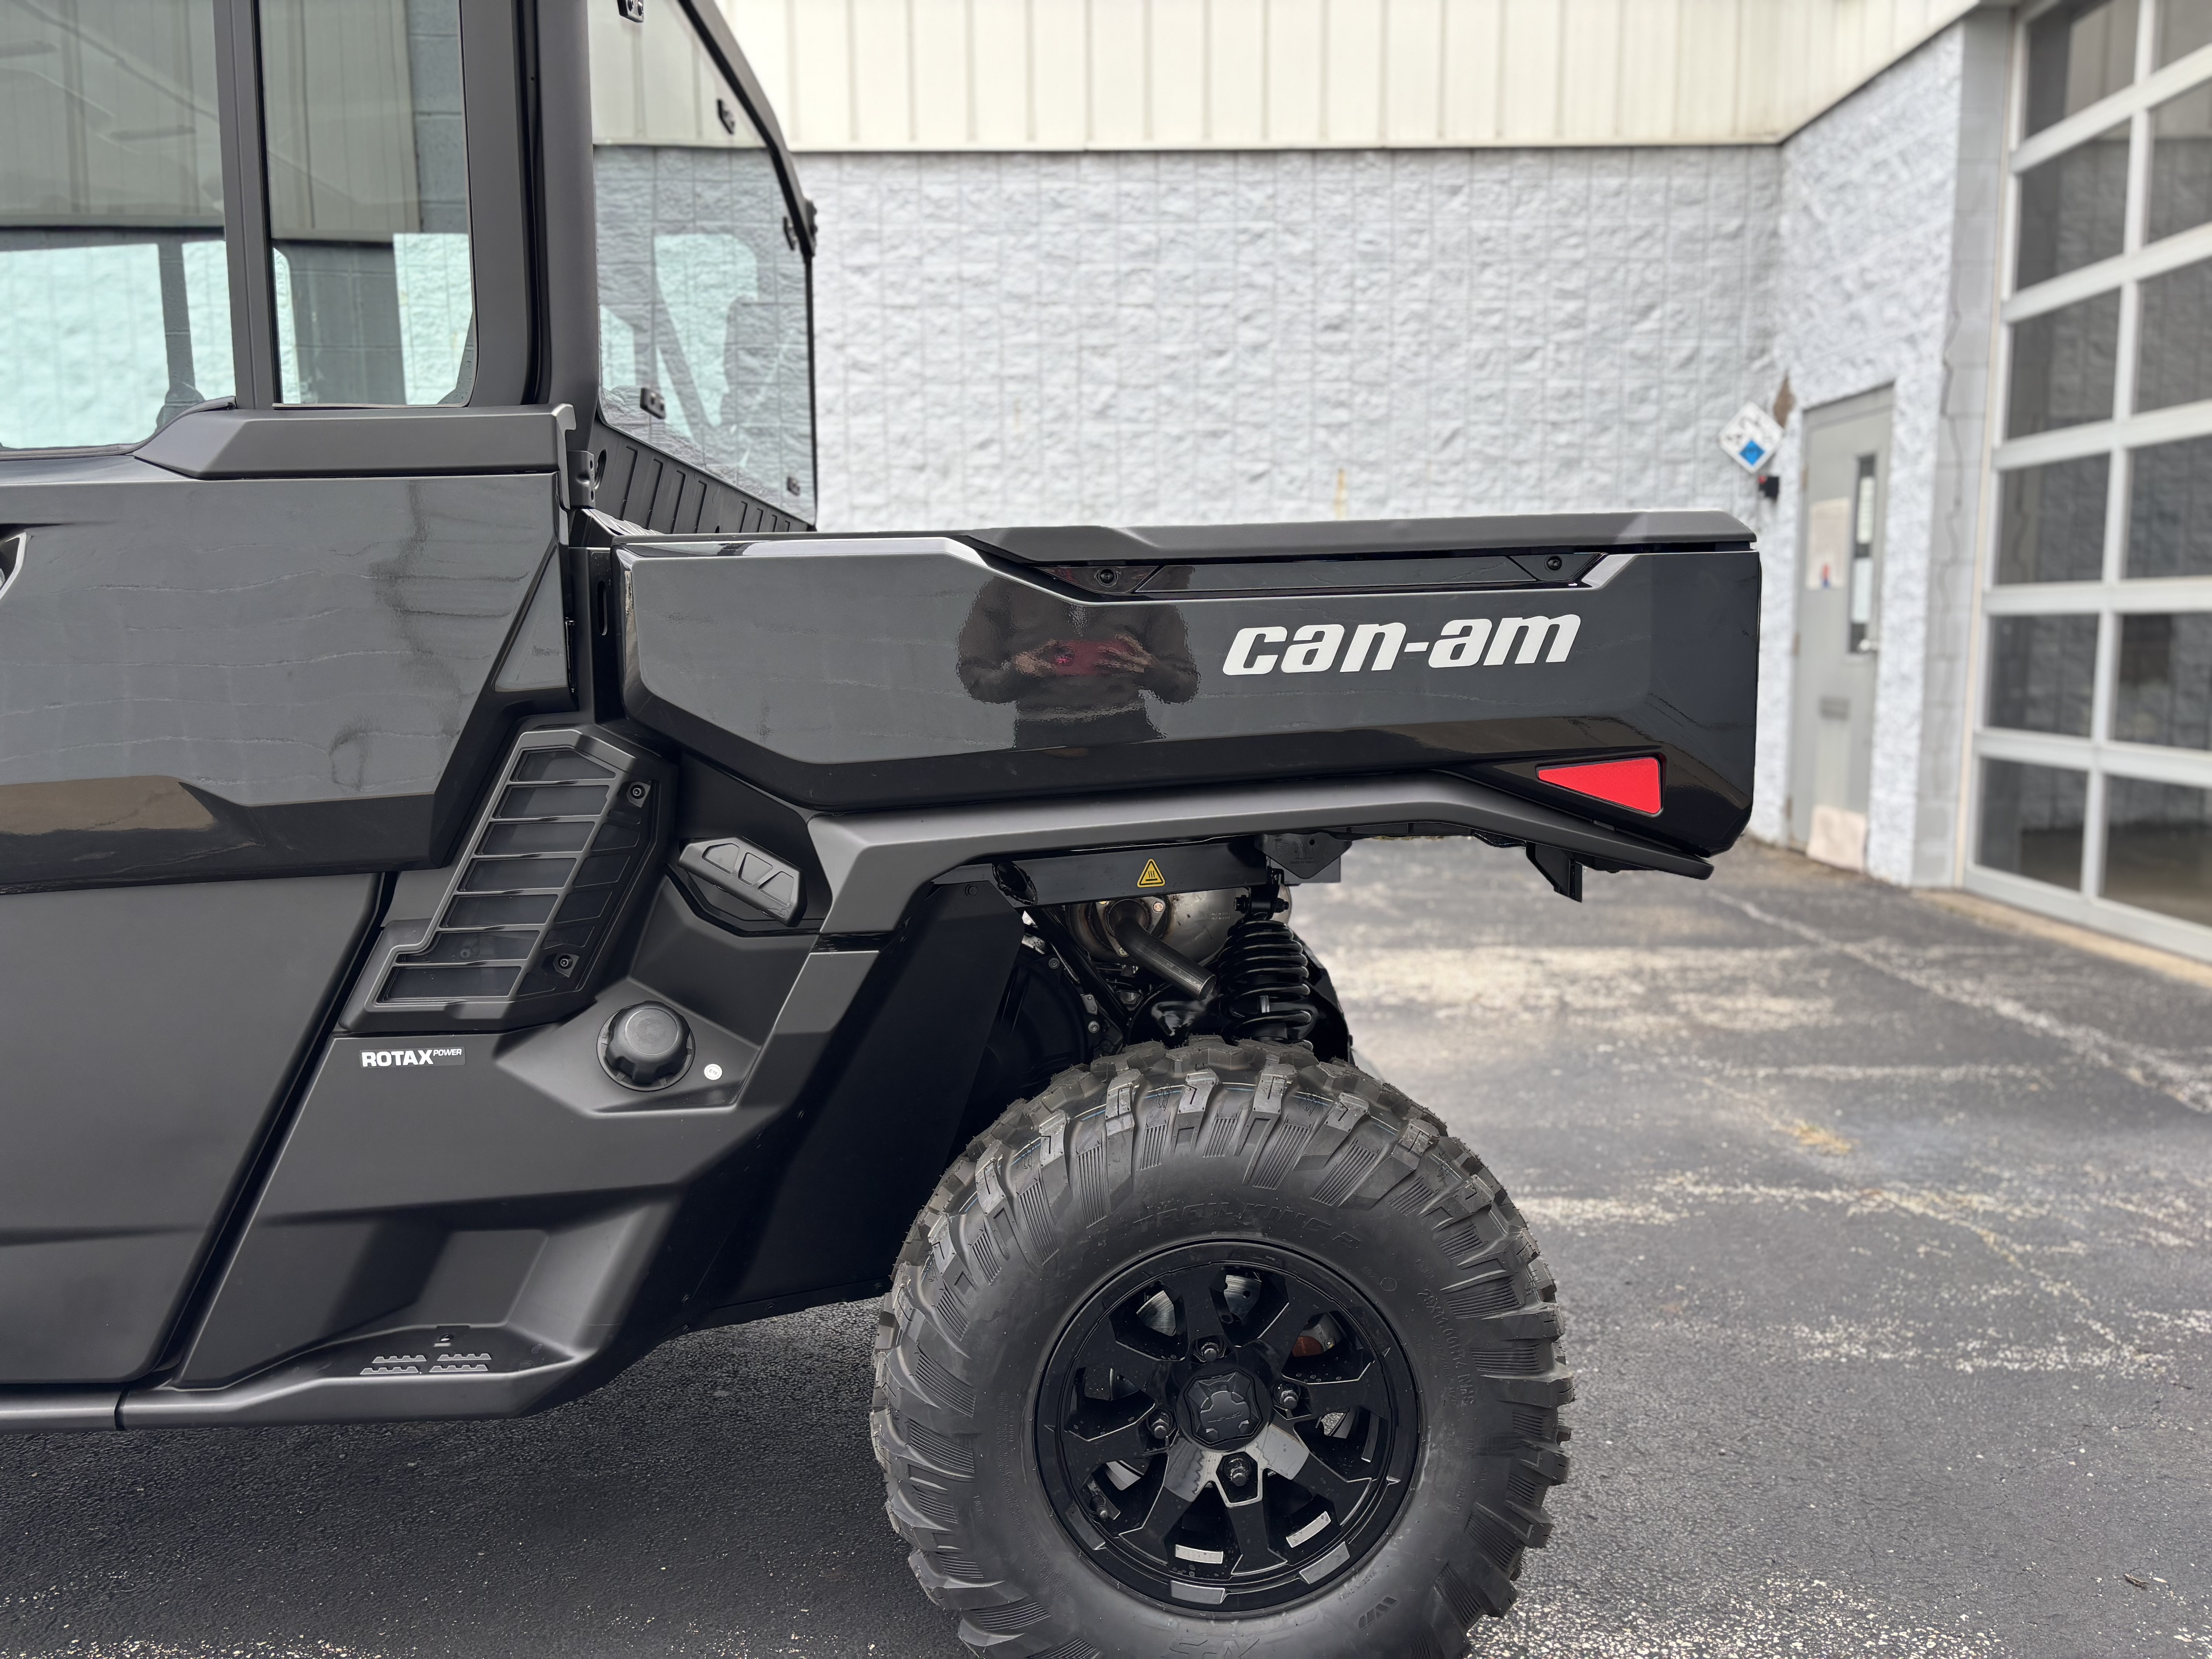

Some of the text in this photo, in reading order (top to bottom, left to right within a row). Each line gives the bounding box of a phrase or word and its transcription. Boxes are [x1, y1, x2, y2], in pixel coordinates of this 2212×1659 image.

[1222, 613, 1581, 676] can-am
[361, 1048, 462, 1067] ROTAX POWER
